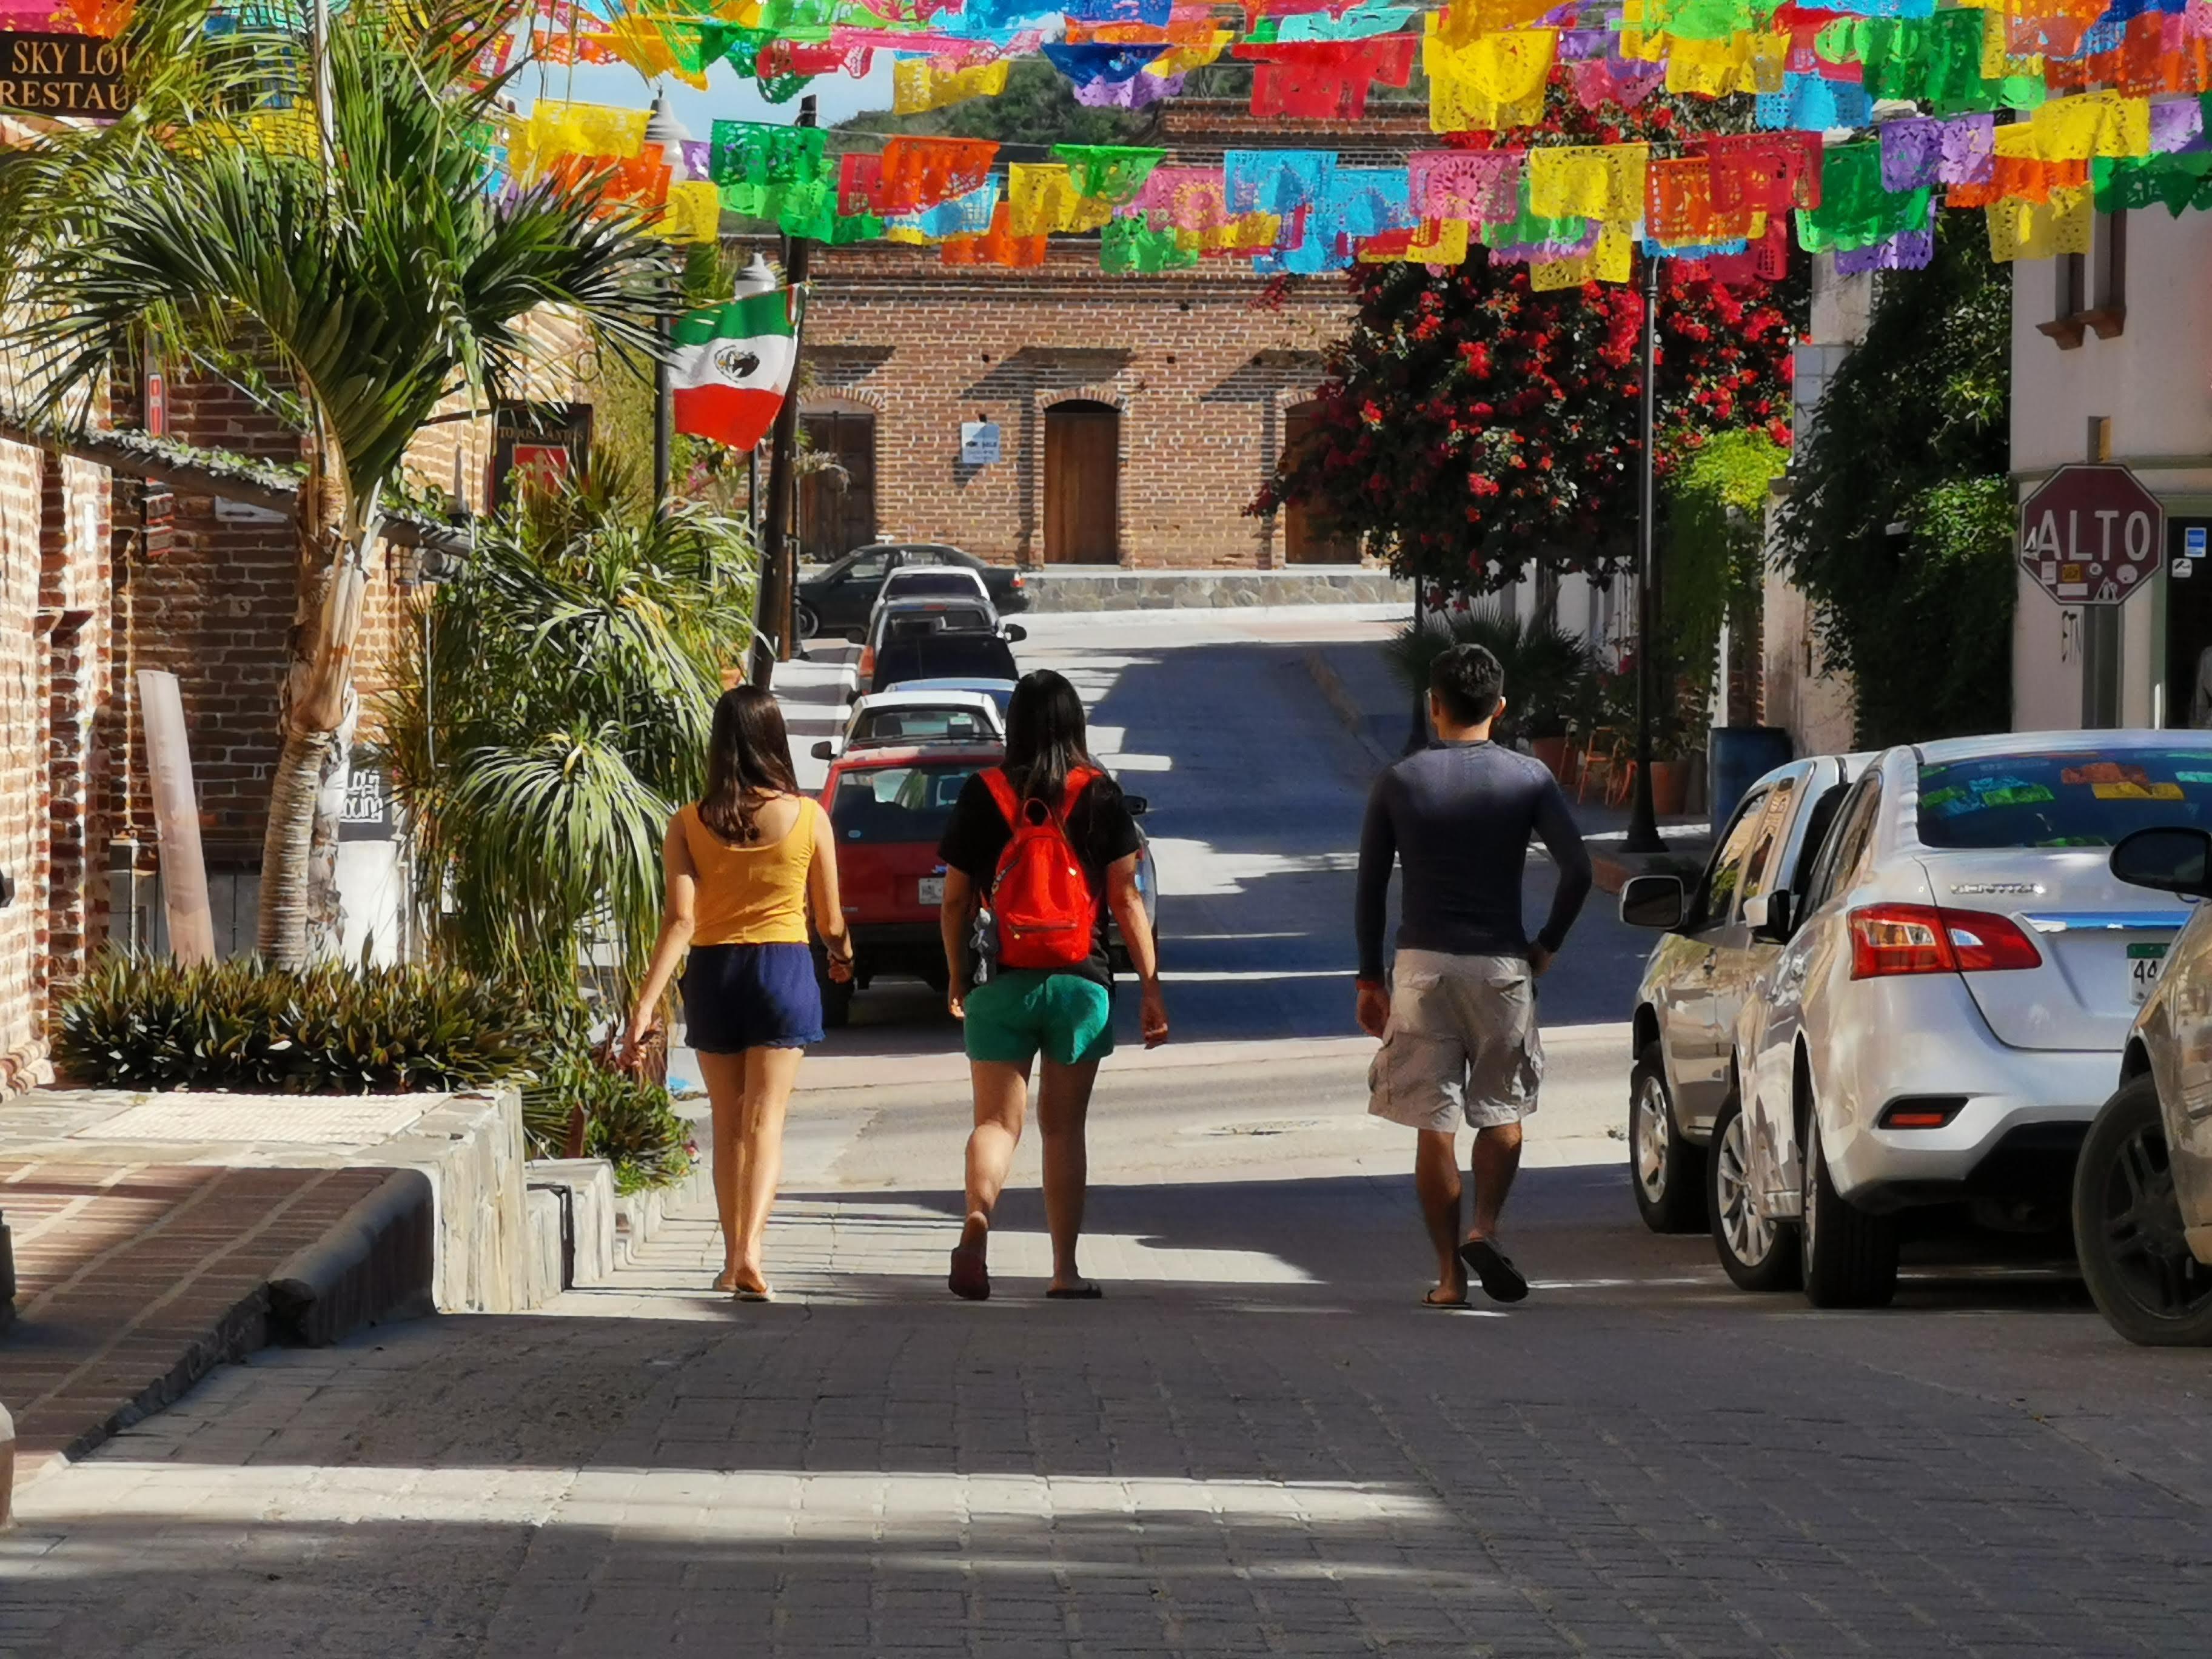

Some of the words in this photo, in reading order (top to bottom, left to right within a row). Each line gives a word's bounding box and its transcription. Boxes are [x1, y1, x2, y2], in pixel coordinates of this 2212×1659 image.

[12, 40, 70, 74] SKY
[0, 79, 135, 111] RESTAU
[2036, 509, 2151, 561] ALTO
